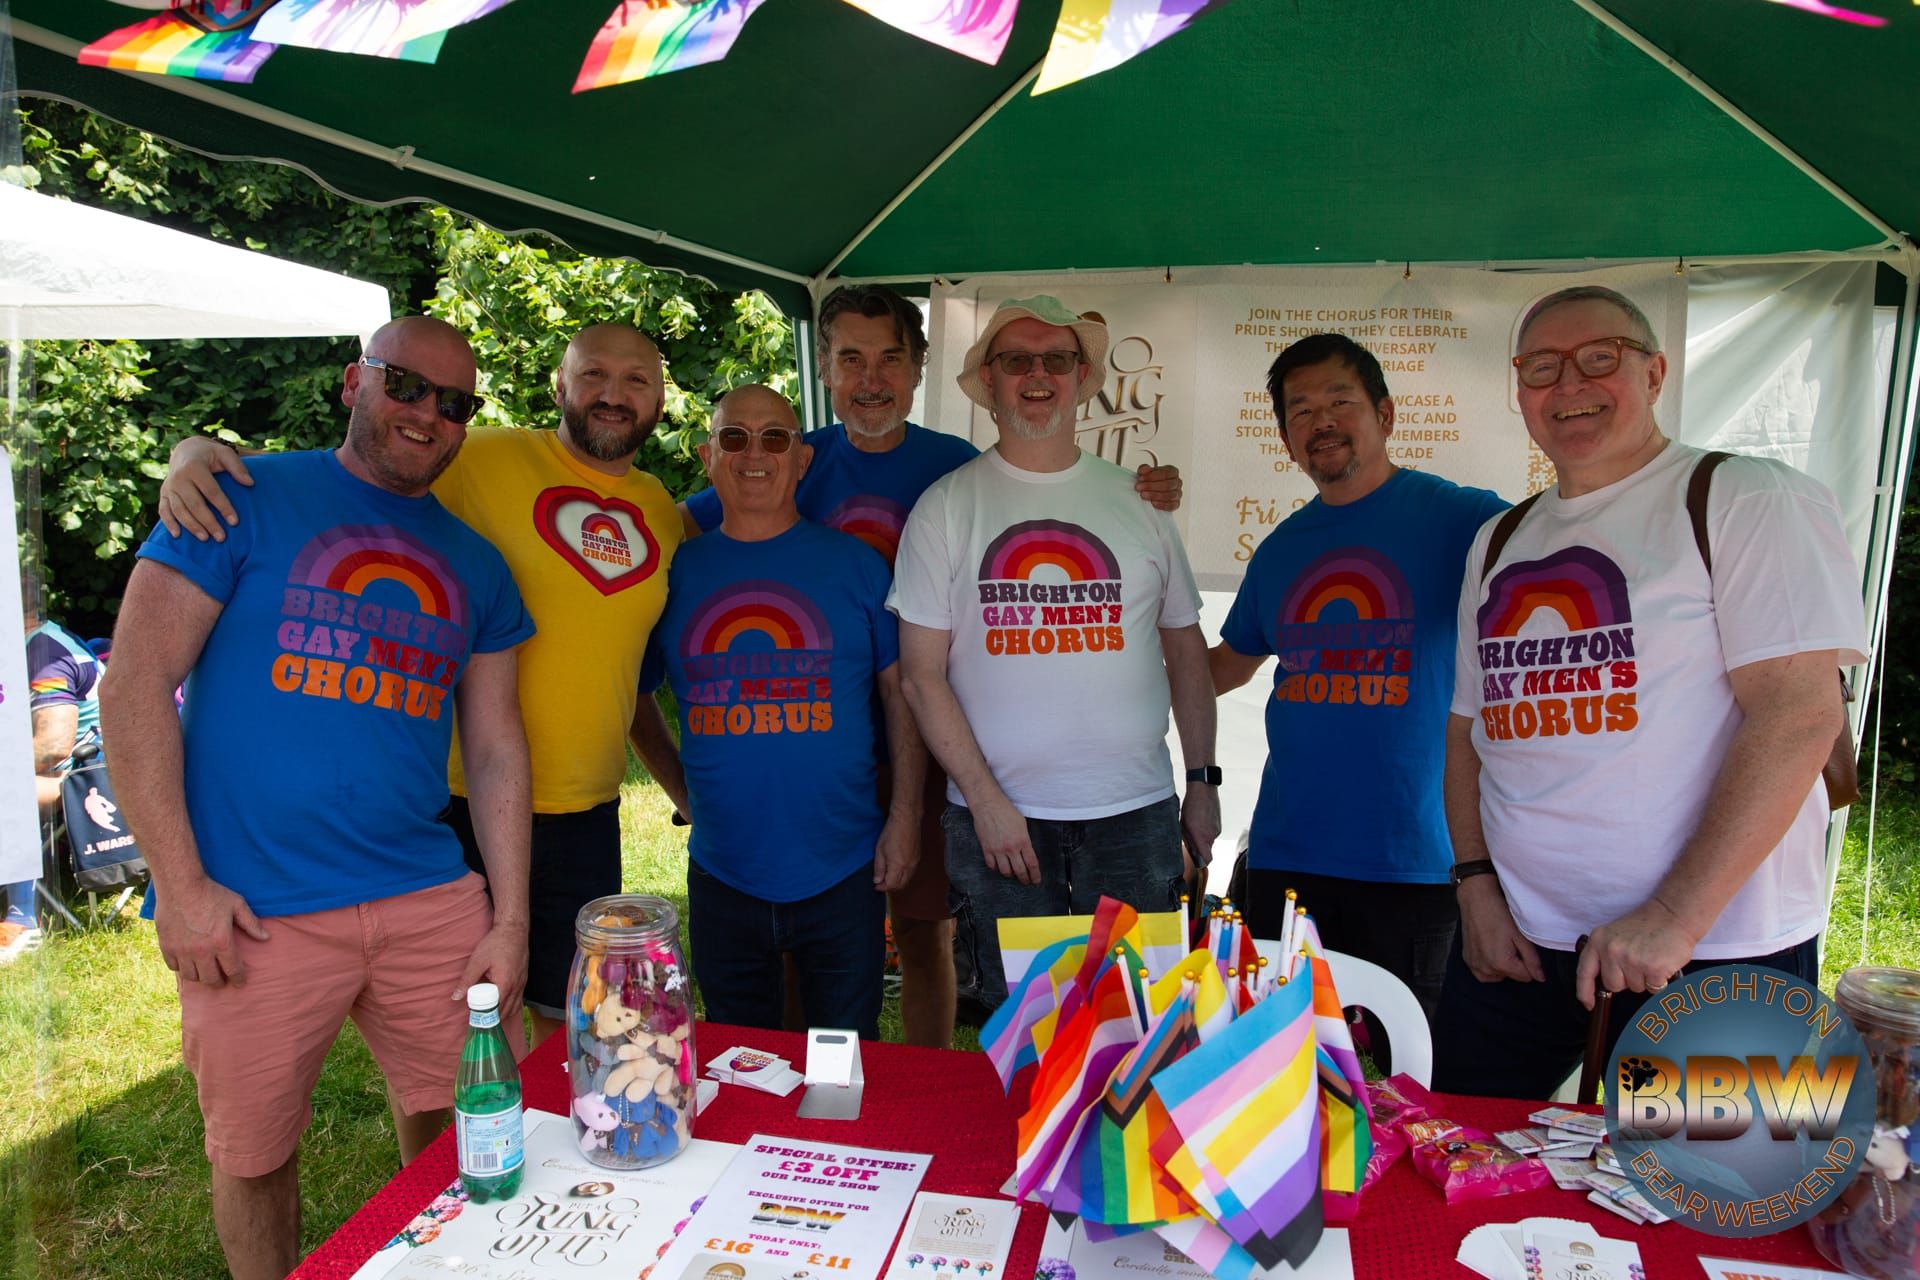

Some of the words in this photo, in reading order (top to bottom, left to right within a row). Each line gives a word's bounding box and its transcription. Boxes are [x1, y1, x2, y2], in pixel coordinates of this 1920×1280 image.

[1248, 308, 1281, 321] JOIN
[1287, 309, 1312, 321] THE
[1317, 309, 1377, 321] CHORUS
[1381, 307, 1408, 320] FOR
[1412, 308, 1453, 321] THEIR
[1235, 324, 1276, 336] PRIDE
[1280, 326, 1323, 338] SHOW
[1329, 326, 1345, 336] AS
[1350, 325, 1384, 337] THEY
[1389, 324, 1468, 339] CELEBRATE
[1360, 342, 1436, 355] IVERSARY
[1382, 360, 1425, 372] RIAGE
[1244, 392, 1270, 404] THE
[1444, 394, 1455, 406] A
[1240, 409, 1273, 420] RICH
[1423, 412, 1457, 424] AND
[1236, 426, 1281, 438] STORI
[1260, 444, 1288, 455] THA
[1388, 447, 1433, 458] ECADE
[1274, 461, 1293, 473] OF
[1236, 496, 1281, 525] Fri
[581, 531, 629, 549] BRIGHTON
[582, 540, 601, 551] GAY
[582, 548, 632, 567] CHORUS
[978, 583, 1122, 604] BRIGHTON
[281, 588, 468, 657] BRIGHTON
[983, 606, 1036, 626] GAY
[1041, 603, 1123, 625] MEN'S
[985, 626, 1124, 656] CHORUS
[277, 621, 360, 659] GAY
[365, 636, 459, 686] MEN'S
[271, 653, 448, 721] CHORUS
[1523, 660, 1638, 696] MEN'S
[688, 701, 833, 735] CHORUS
[1481, 692, 1639, 741] CHORUS
[754, 1144, 837, 1163] SPECIAL
[844, 1155, 917, 1172] OFFER:
[778, 1161, 814, 1174] £3
[822, 1165, 879, 1182] OFF
[761, 1171, 789, 1180] OUR
[792, 1174, 835, 1186] PRIDE
[838, 1181, 880, 1192] SHOW
[748, 1190, 807, 1203] EXCLUSIVE
[809, 1199, 845, 1209] OFFER
[847, 1204, 870, 1212] FOR
[748, 1233, 787, 1244] TODAY
[704, 1237, 755, 1255] £16
[765, 1248, 790, 1257] AND
[807, 1252, 851, 1270] £11
